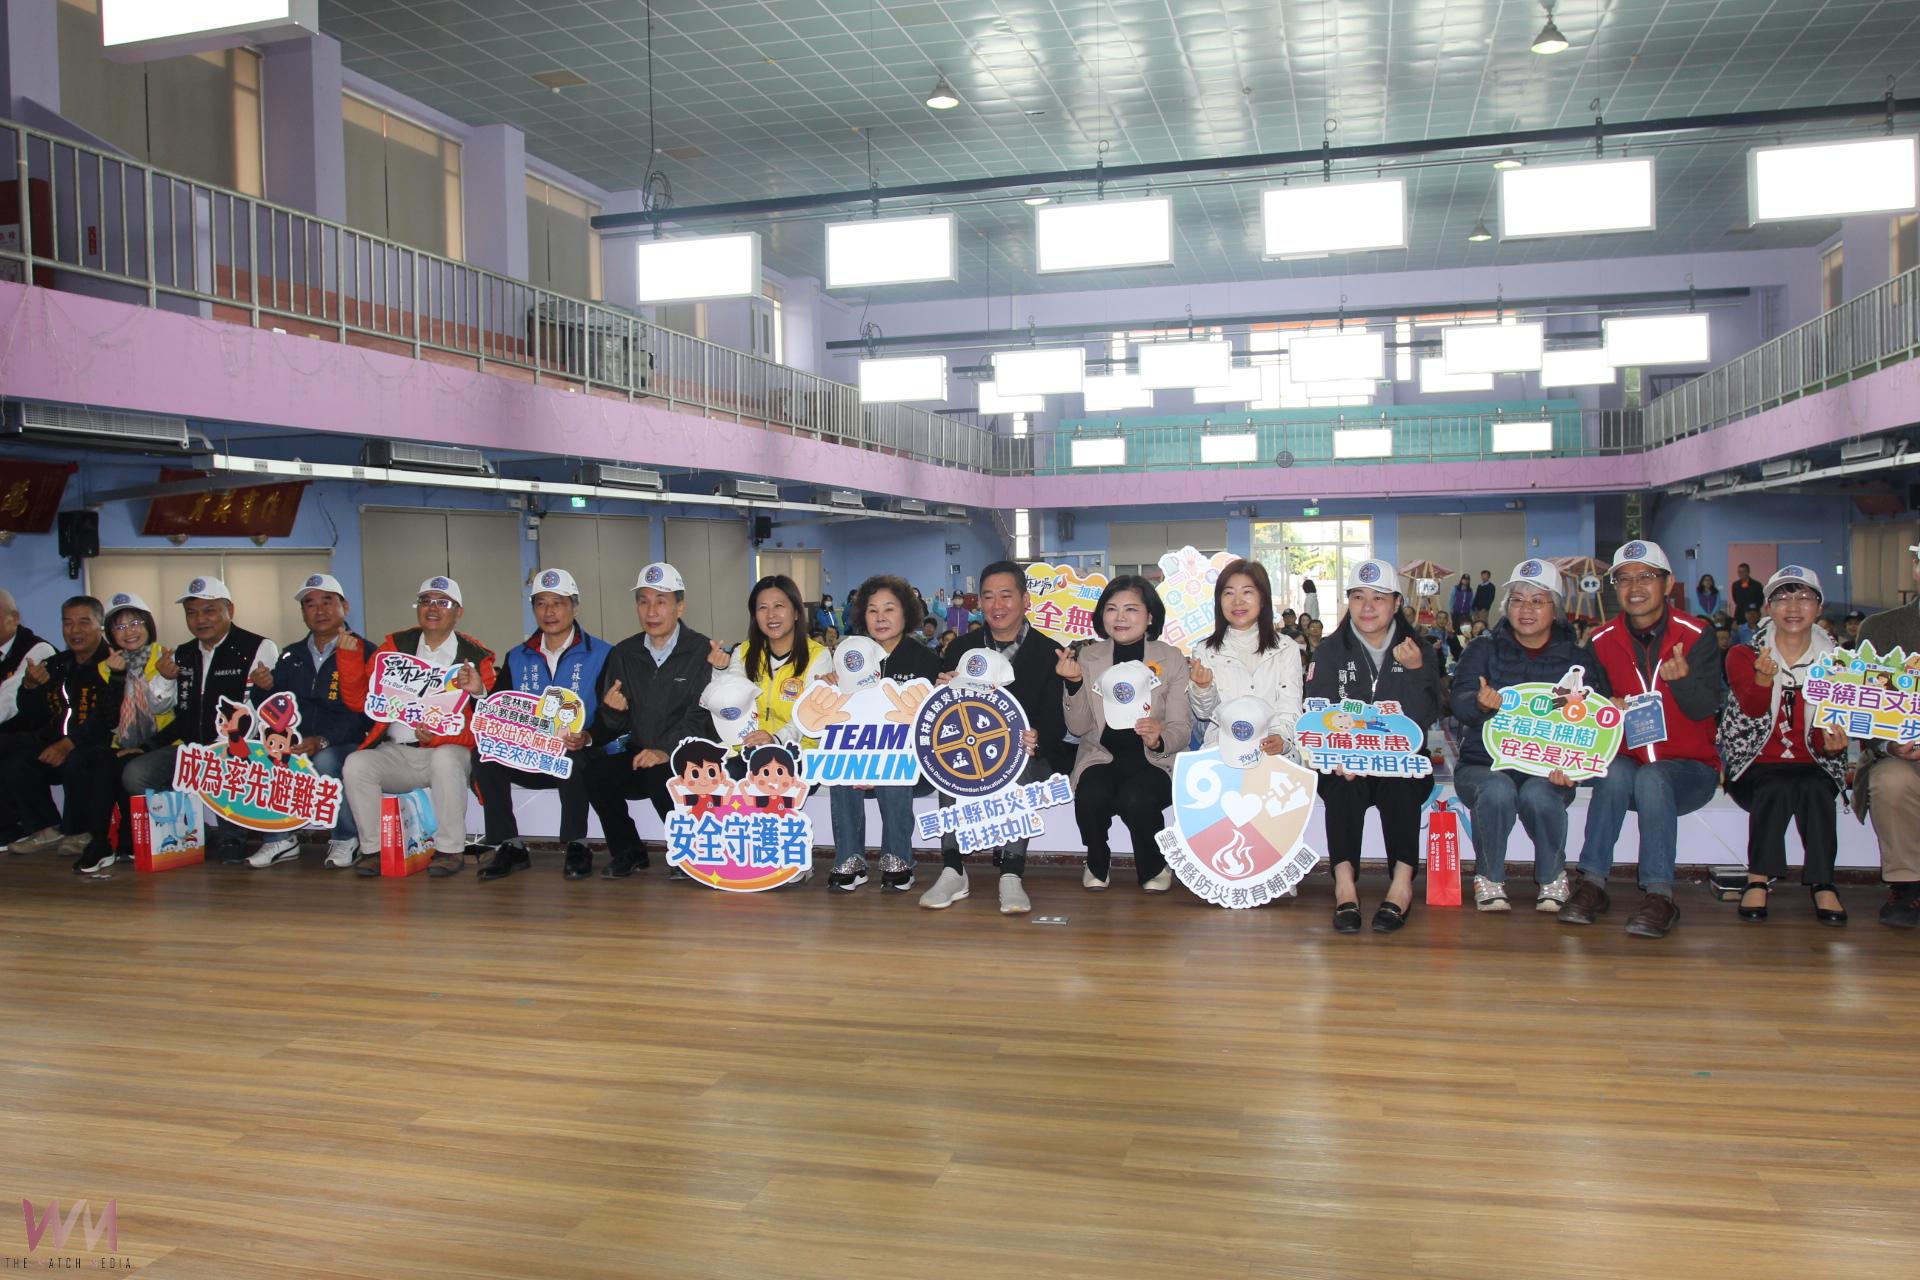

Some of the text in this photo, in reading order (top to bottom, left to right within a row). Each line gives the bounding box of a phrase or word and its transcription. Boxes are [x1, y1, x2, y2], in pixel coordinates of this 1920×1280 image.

[1024, 601, 1097, 636] 全無
[478, 701, 551, 730] 防災教育輔導團
[499, 695, 532, 712] 雲林縣
[1567, 705, 1580, 719] C
[1601, 710, 1615, 725] D
[824, 724, 911, 750] TEAM
[1490, 713, 1598, 748] 幸福是棵樹
[1822, 707, 1920, 740] 不冒一步
[1297, 731, 1412, 752] 有備無患
[1500, 738, 1607, 774] 安全是沃土
[805, 754, 918, 780] YUNLIN
[1313, 752, 1429, 773] 平安相伴
[177, 747, 339, 824] 成為率先避難者
[979, 777, 1005, 792] Education
[919, 777, 1071, 837] 雲林縣防災教育
[670, 815, 807, 865] 安全守護者
[958, 813, 1042, 851] 科技中心
[1158, 830, 1316, 906] 雲林縣防災教育輔導團
